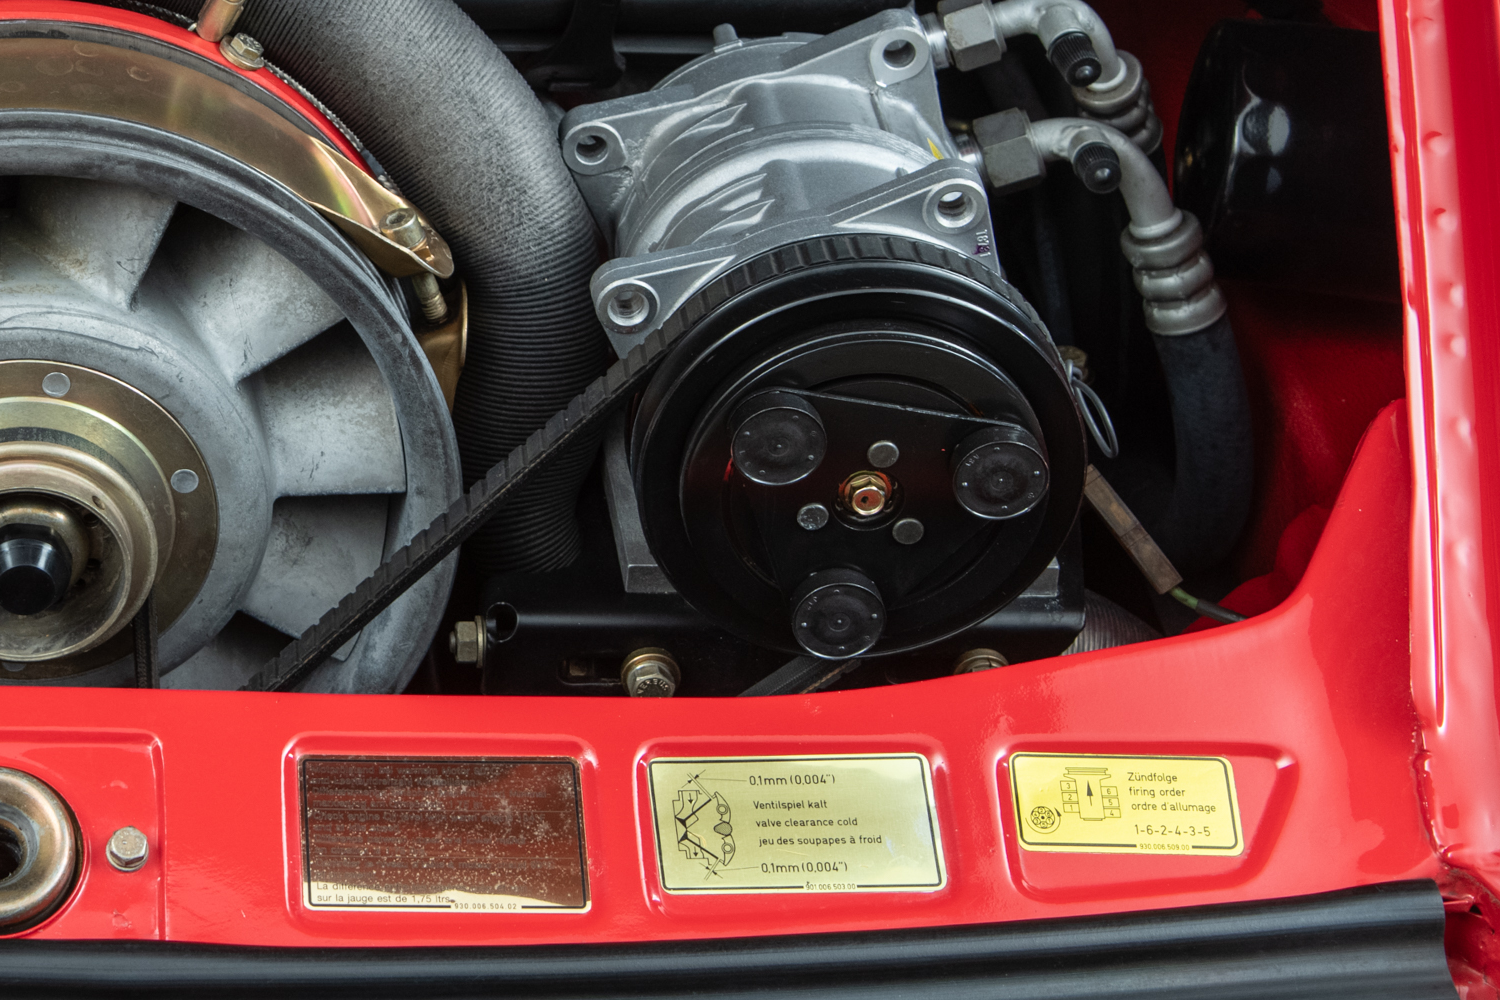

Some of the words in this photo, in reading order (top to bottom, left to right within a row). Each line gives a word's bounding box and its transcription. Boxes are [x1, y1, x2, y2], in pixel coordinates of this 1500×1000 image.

[1127, 772, 1178, 784] Zündfolge
[1129, 786, 1155, 798] firing
[1160, 788, 1186, 797] order
[753, 800, 805, 811] Ventilspiel
[808, 800, 828, 808] kalt
[1132, 802, 1158, 810] ordre
[1161, 802, 1216, 814] d'allumage
[756, 818, 782, 828] valve
[784, 818, 834, 827] clearance
[838, 817, 858, 826] cold
[1134, 824, 1211, 836] 1-6-2-4-3-5
[759, 836, 774, 847] jeu
[776, 836, 794, 846] des
[798, 838, 846, 846] soupapes
[850, 836, 856, 844] à
[859, 835, 882, 844] froid
[316, 882, 328, 890] La
[317, 894, 332, 902] sur
[335, 894, 344, 902] la
[347, 894, 374, 904] jauge
[395, 894, 408, 902] de
[412, 894, 432, 904] 1,75
